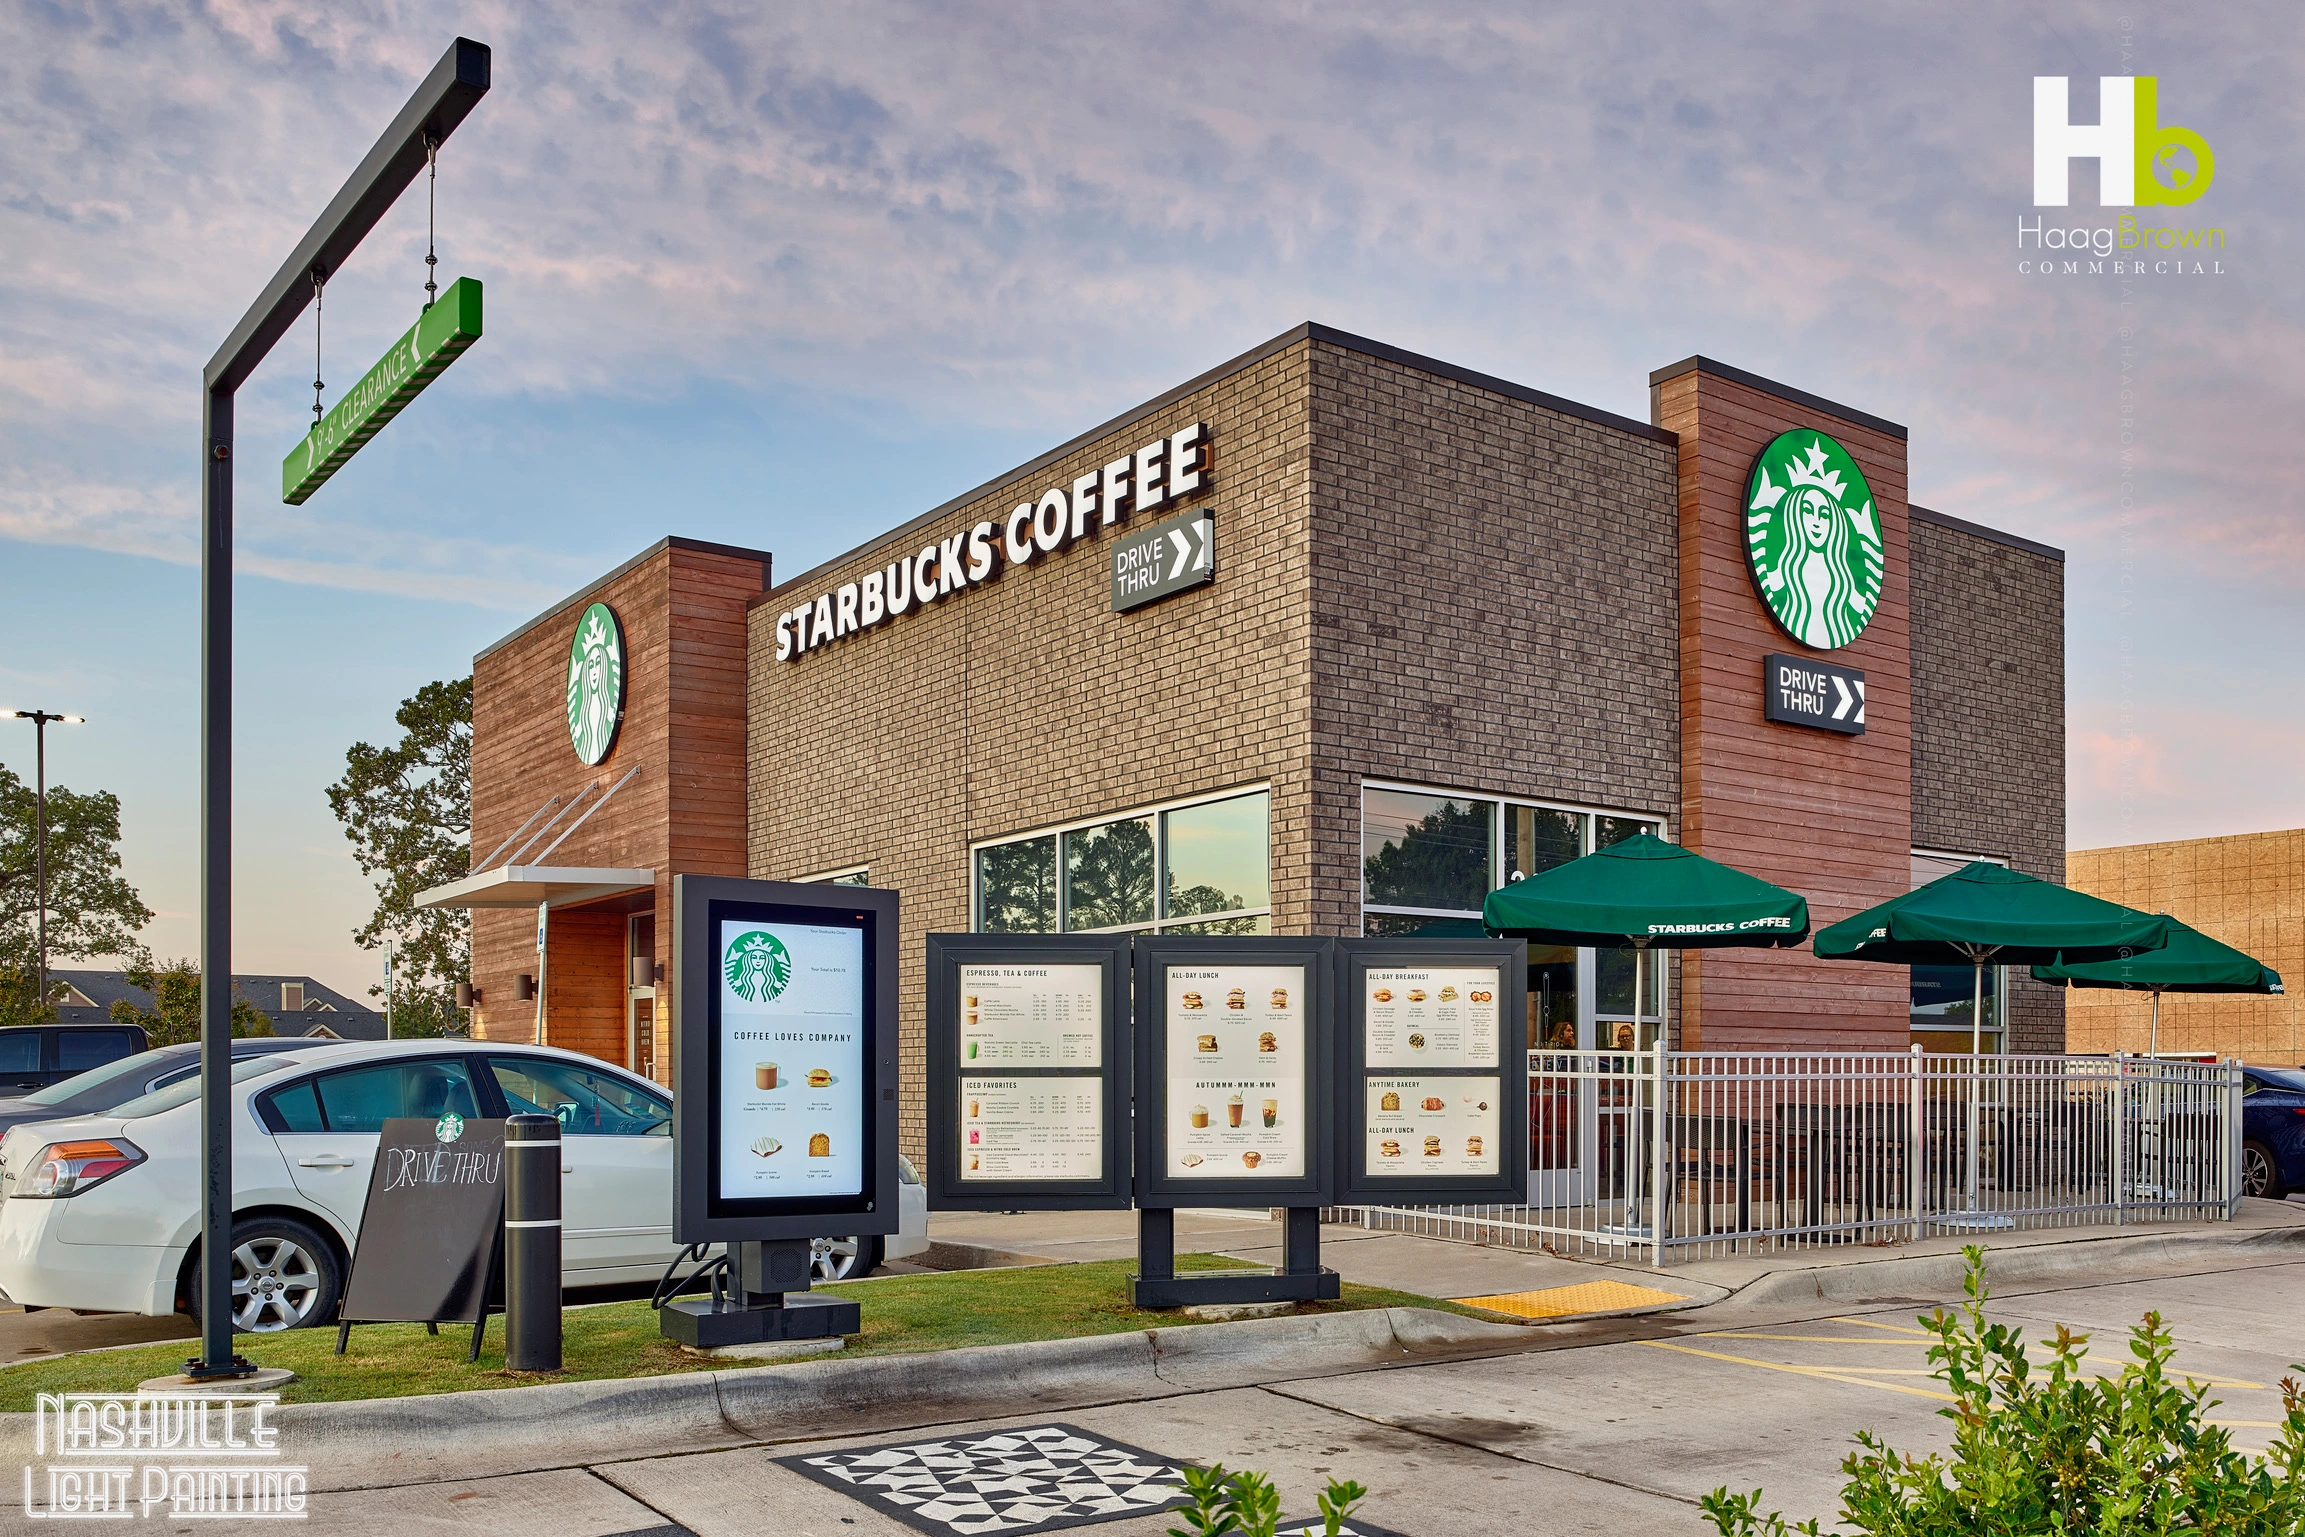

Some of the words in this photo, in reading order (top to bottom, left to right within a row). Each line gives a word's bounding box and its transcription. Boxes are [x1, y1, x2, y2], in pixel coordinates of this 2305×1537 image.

[341, 342, 407, 430] CLEARANCE
[775, 521, 996, 662] STARBUCKS
[1004, 422, 1207, 566] COFFEE
[1116, 536, 1163, 575] DRIVE
[1117, 562, 1161, 597] THRU
[1779, 666, 1827, 695] DRIVE
[1780, 689, 1824, 716] THRU
[1648, 922, 1734, 934] STARBUCKS
[1739, 917, 1791, 930] COFFEE
[734, 1032, 770, 1040] COFFEE
[775, 1032, 804, 1041] LOVES
[809, 1033, 851, 1042] COMPANY
[383, 1148, 451, 1191] DRIVE
[452, 1151, 501, 1184] THRU
